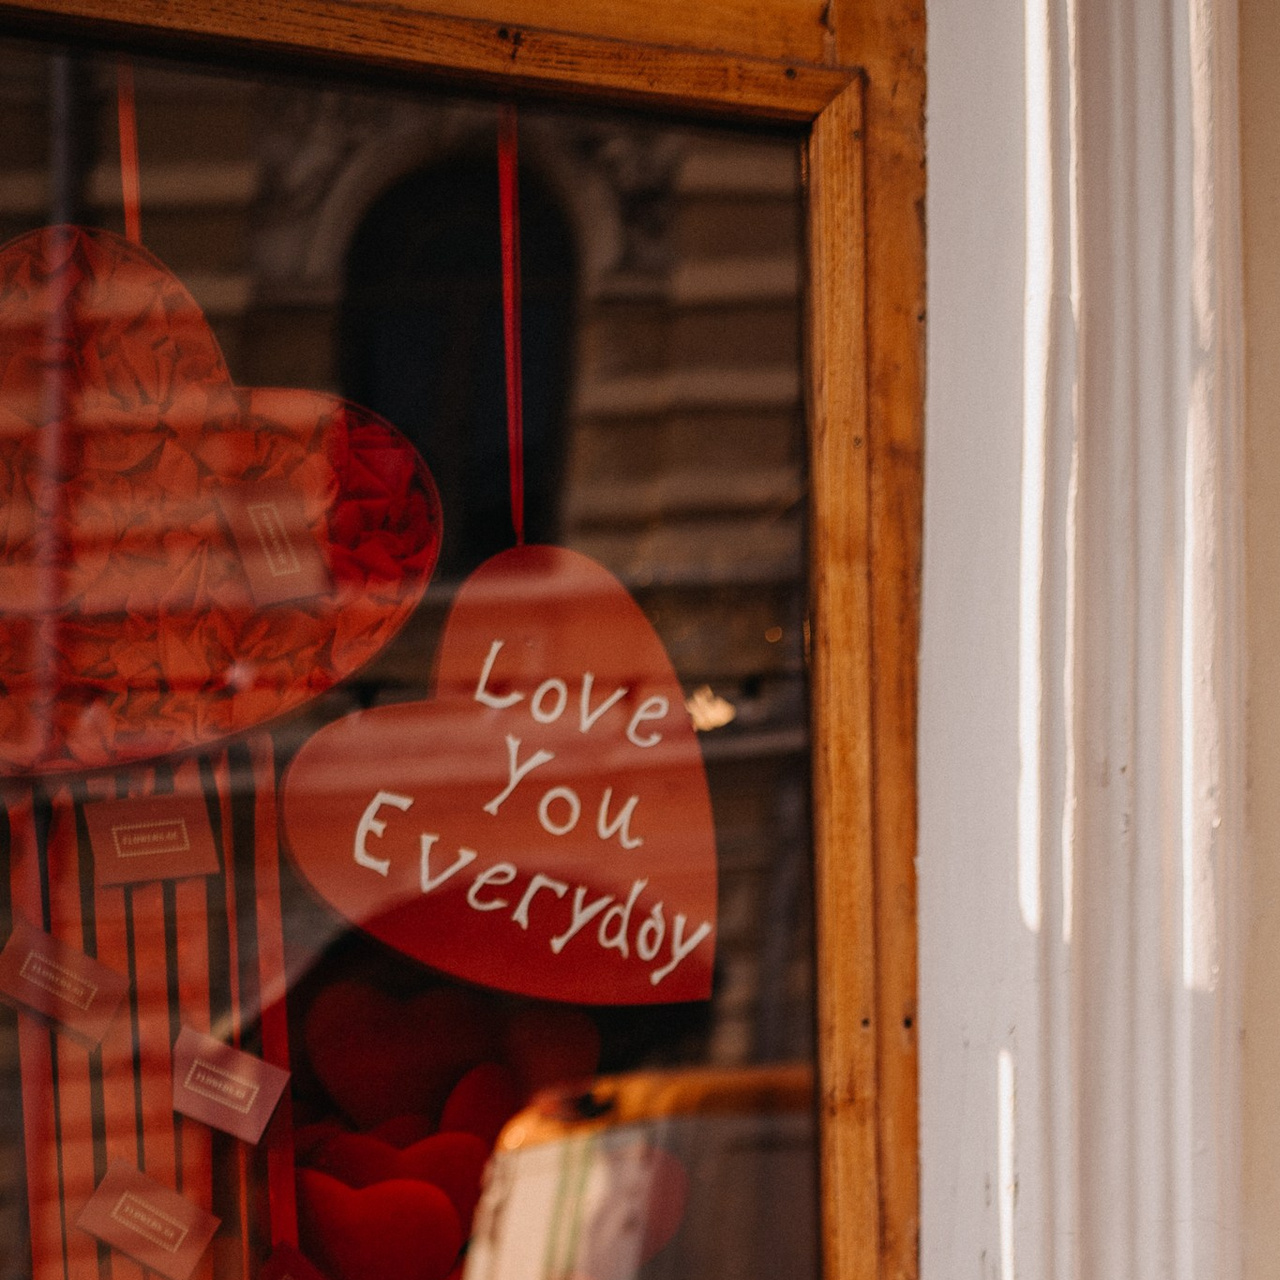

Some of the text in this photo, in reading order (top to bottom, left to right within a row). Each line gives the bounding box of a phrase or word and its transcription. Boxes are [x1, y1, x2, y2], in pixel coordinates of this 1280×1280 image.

[474, 640, 668, 748] Love
[483, 735, 643, 849] You
[353, 791, 713, 985] Everyday
